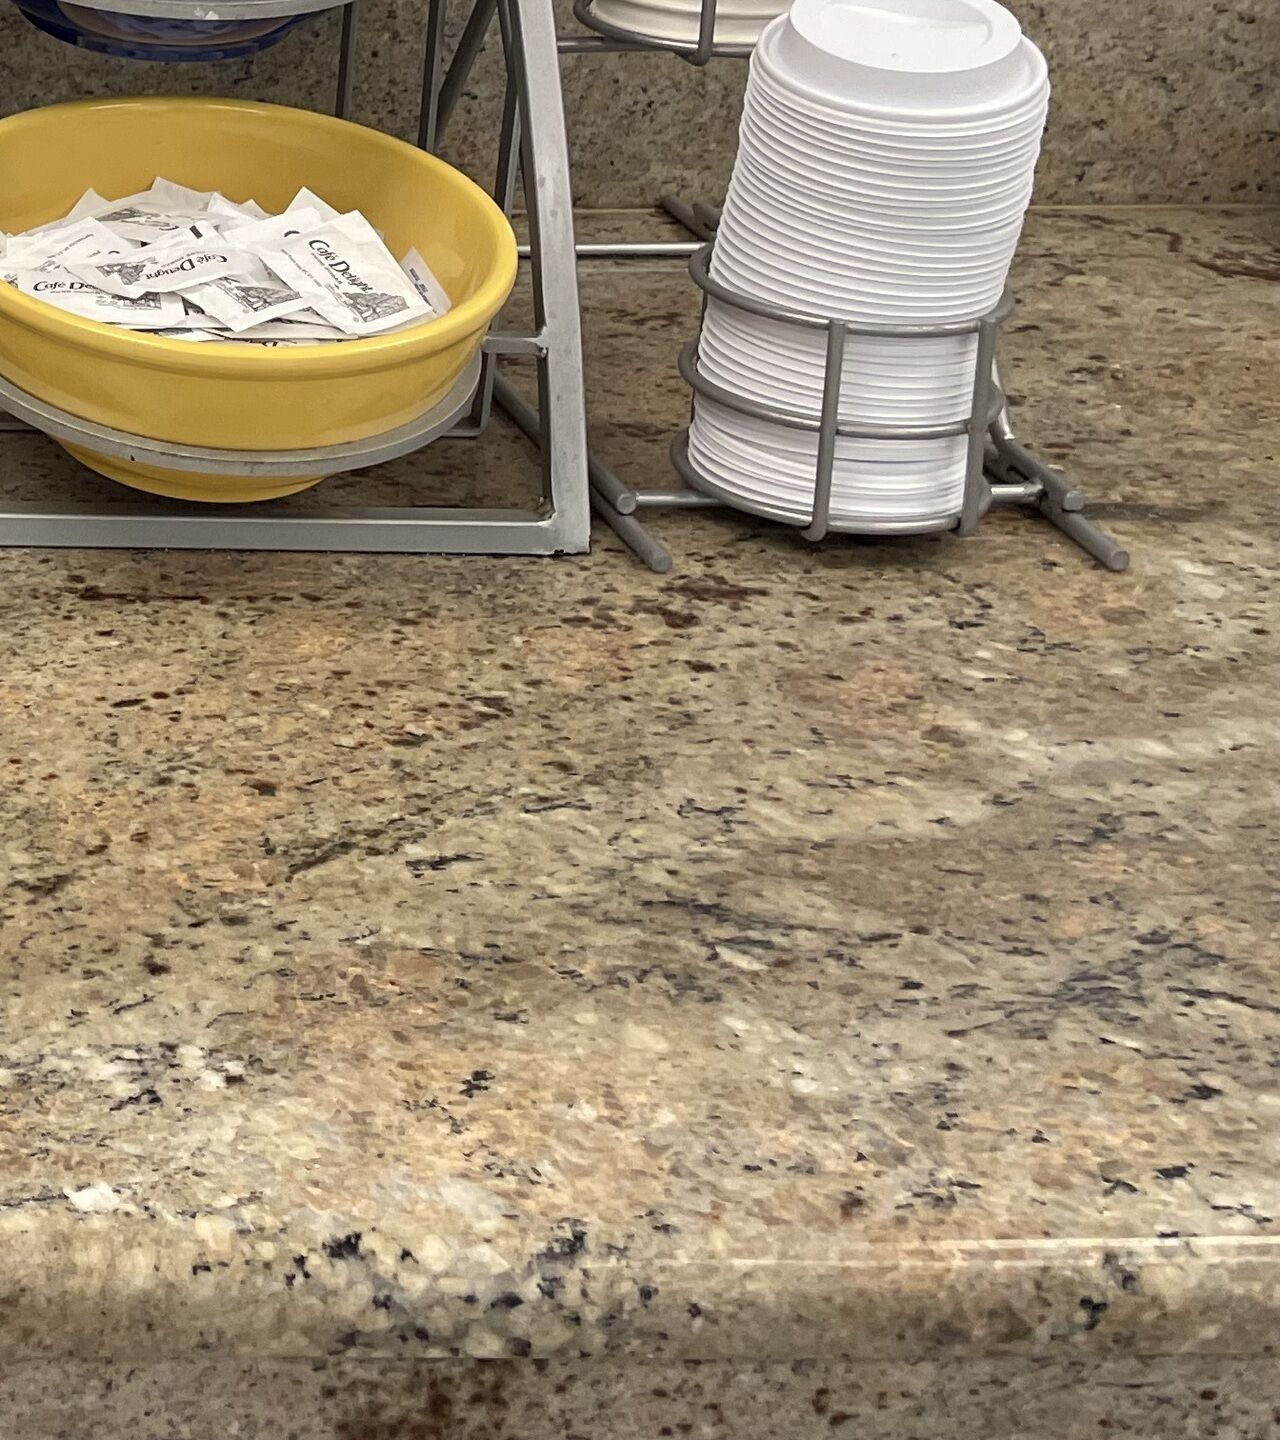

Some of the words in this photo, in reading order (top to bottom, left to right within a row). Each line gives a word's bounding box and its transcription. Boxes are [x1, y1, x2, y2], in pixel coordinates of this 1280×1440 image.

[308, 239, 339, 262] Café
[328, 260, 374, 293] Delight
[33, 280, 66, 292] Café
